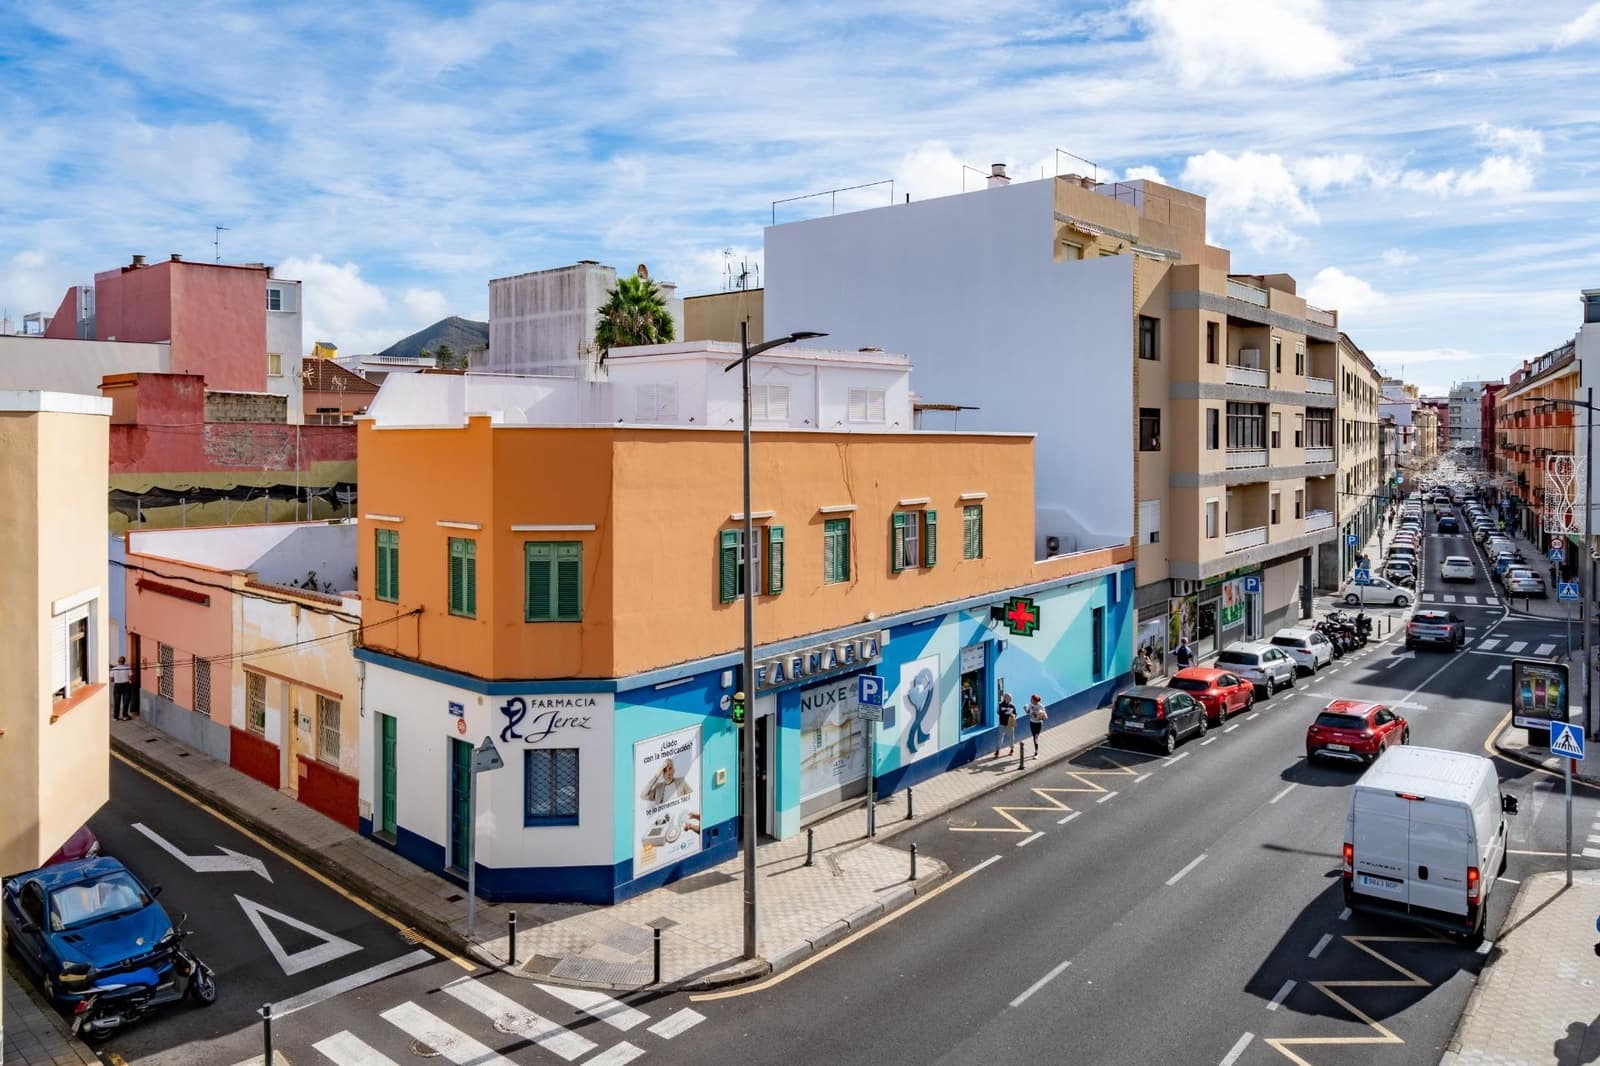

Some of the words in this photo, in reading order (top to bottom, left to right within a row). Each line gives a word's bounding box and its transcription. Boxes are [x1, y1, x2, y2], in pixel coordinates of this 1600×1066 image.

[1247, 578, 1257, 590] P
[754, 636, 880, 690] FARMACIA
[801, 687, 848, 712] NUXE
[862, 679, 878, 702] P
[531, 698, 597, 709] FARMACIA
[524, 710, 592, 744] Jerez
[643, 755, 654, 764] con
[654, 752, 660, 761] la
